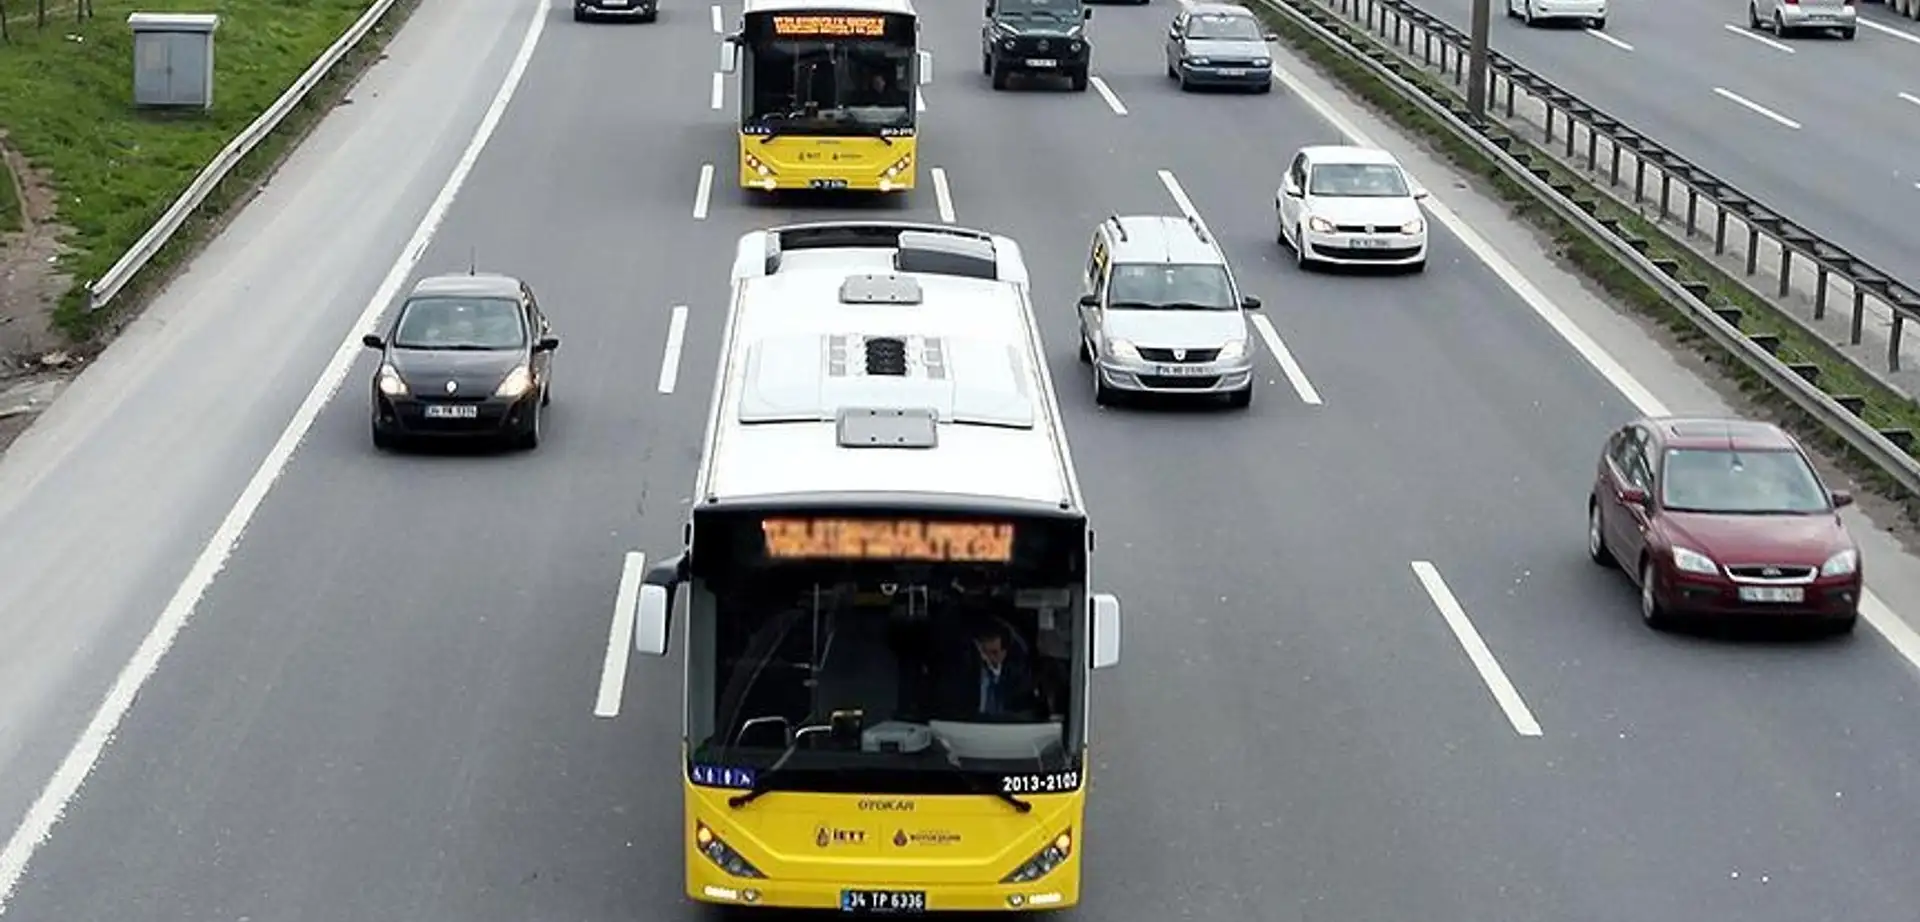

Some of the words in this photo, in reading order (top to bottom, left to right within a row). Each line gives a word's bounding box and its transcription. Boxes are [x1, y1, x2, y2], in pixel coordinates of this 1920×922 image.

[858, 800, 914, 811] OTOKAR
[851, 891, 866, 907] 34
[872, 892, 888, 907] TP
